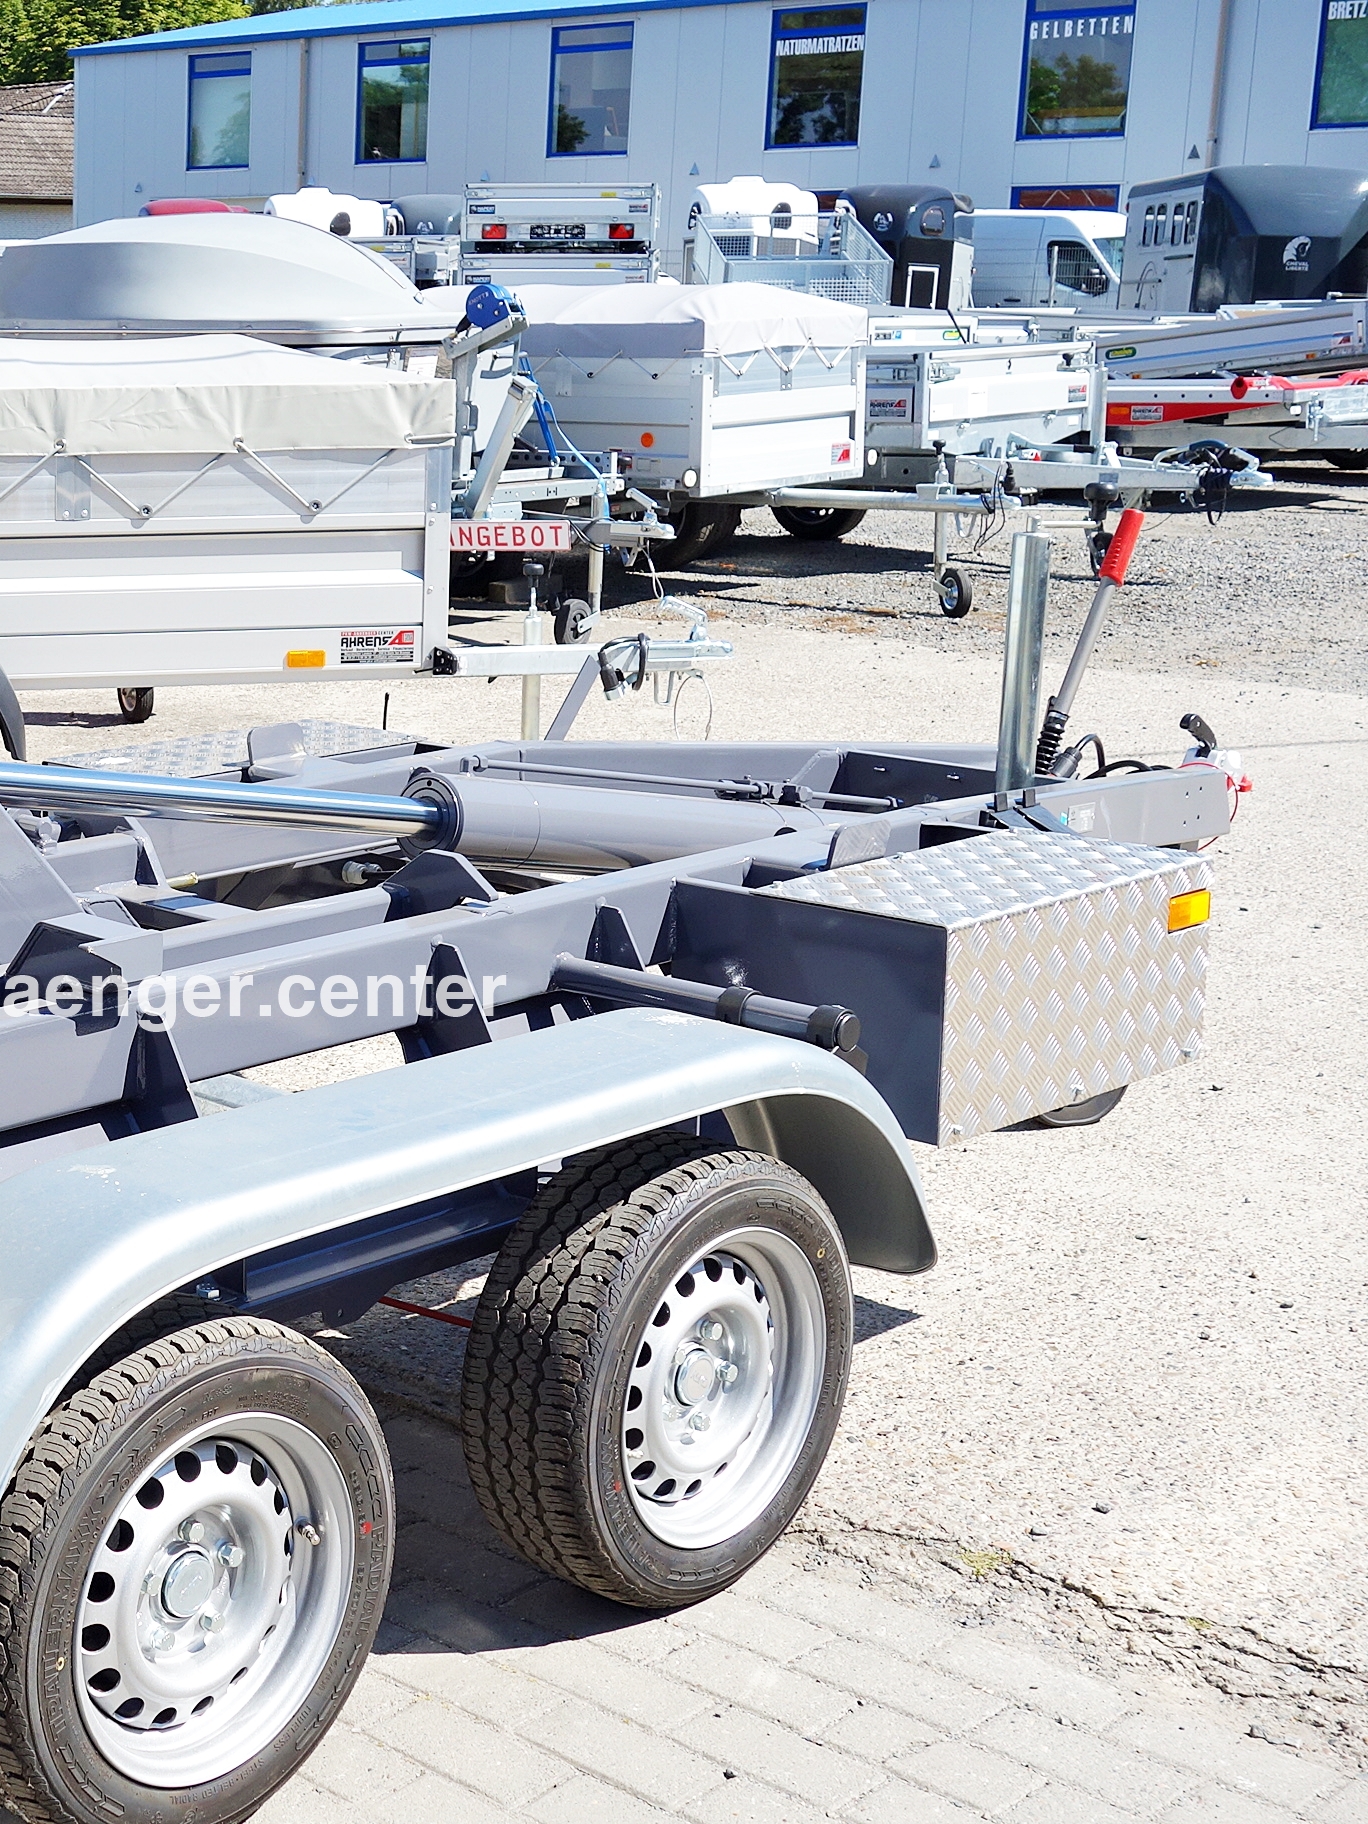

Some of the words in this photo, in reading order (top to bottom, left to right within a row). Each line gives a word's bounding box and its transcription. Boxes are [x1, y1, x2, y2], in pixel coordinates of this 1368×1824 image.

[1328, 0, 1368, 20] BRETZ
[1030, 16, 1134, 40] GELBETTEN
[775, 34, 865, 56] NATURMATRATZEN
[341, 636, 393, 648] AHRENS
